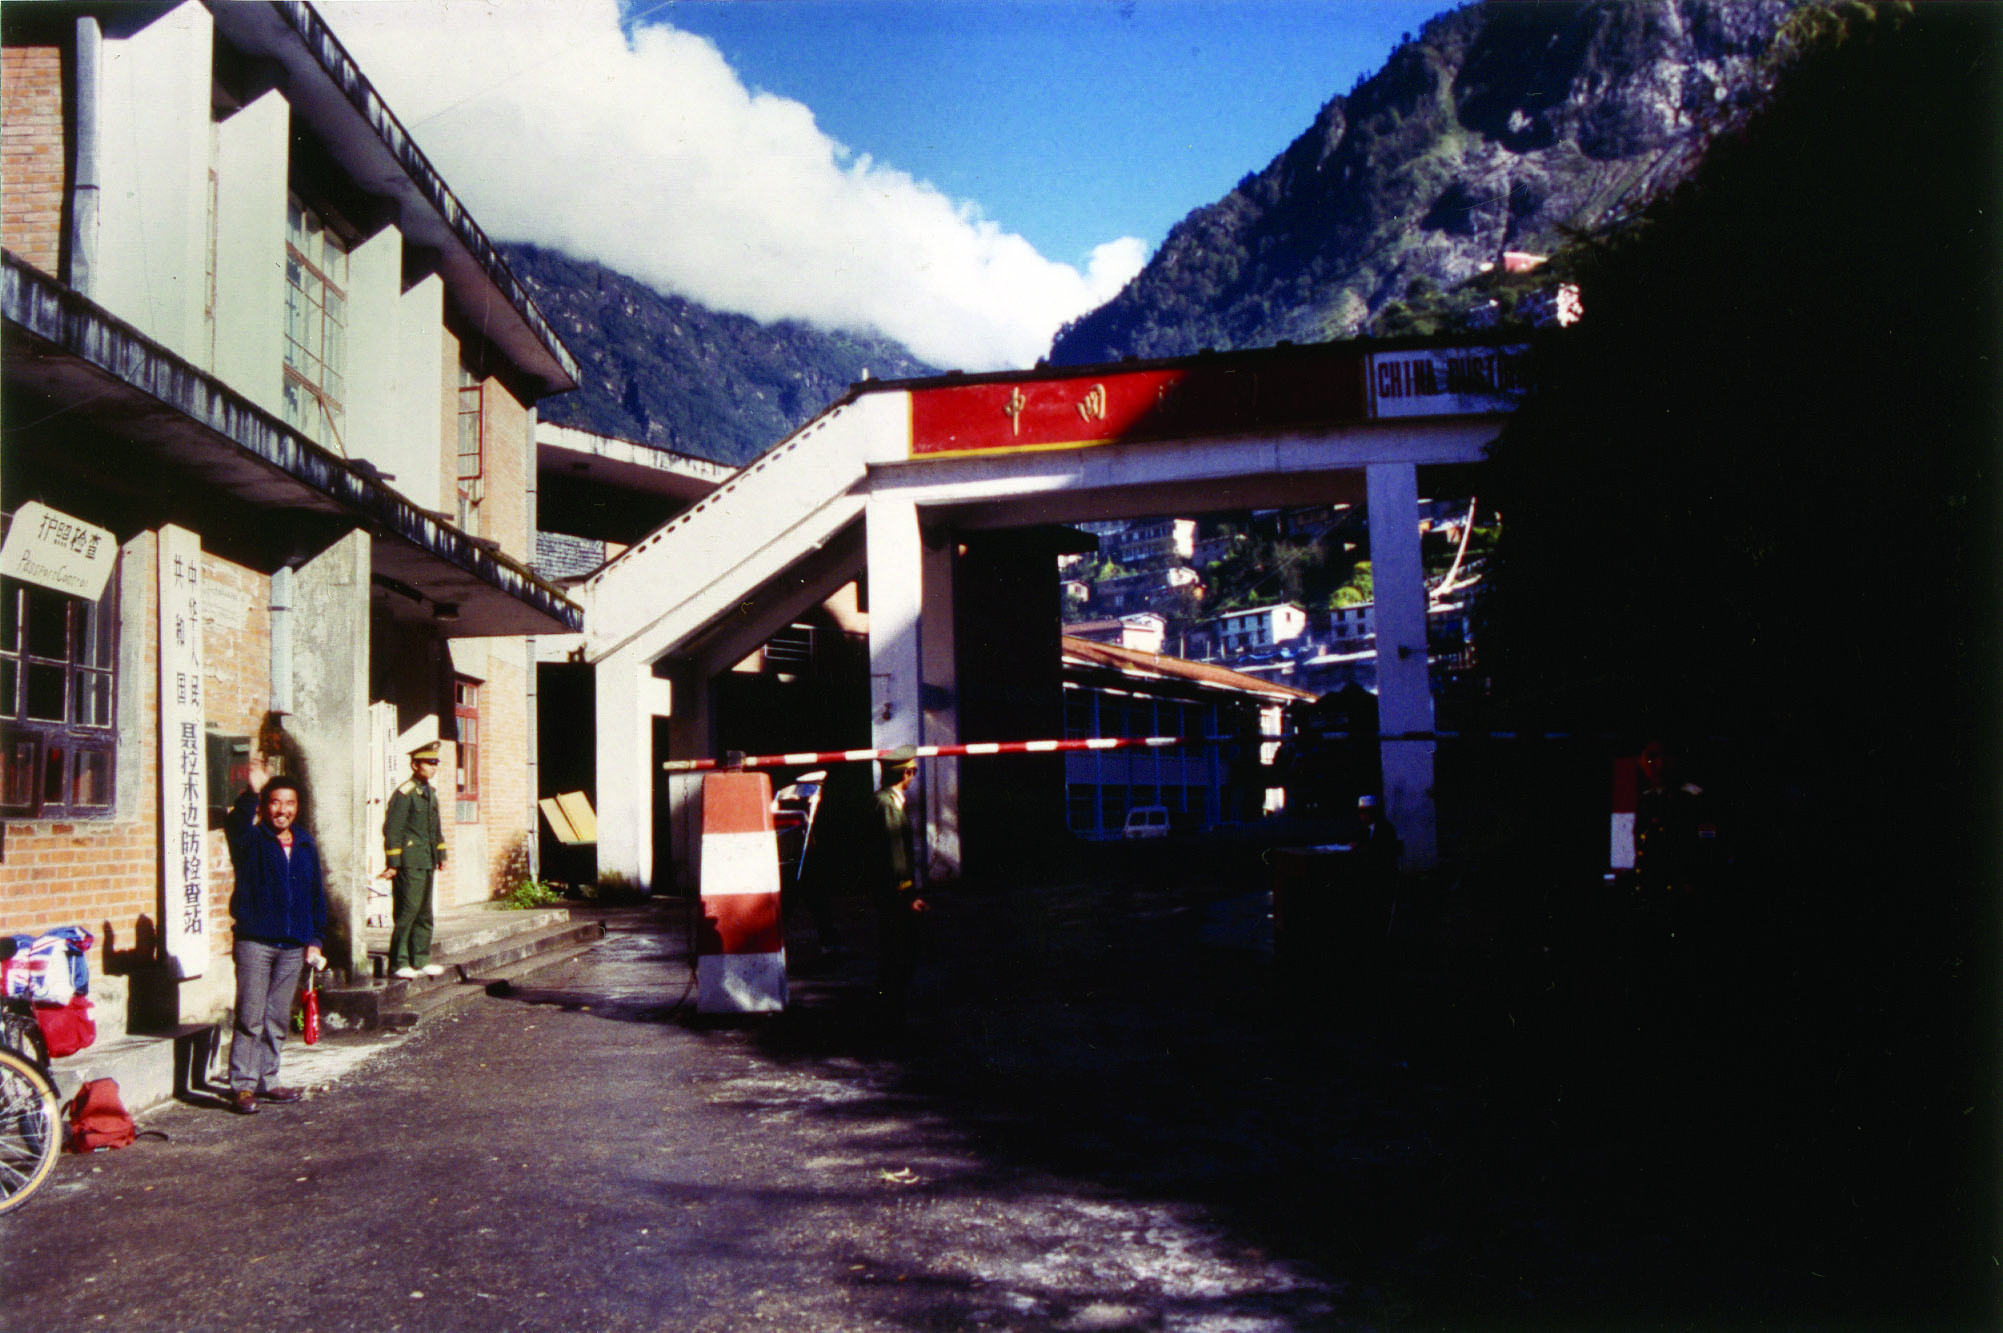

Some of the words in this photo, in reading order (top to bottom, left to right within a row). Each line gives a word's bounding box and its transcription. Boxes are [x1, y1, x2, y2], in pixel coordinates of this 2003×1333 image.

[1378, 359, 1438, 398] CHINA
[37, 512, 102, 560] 护照检查
